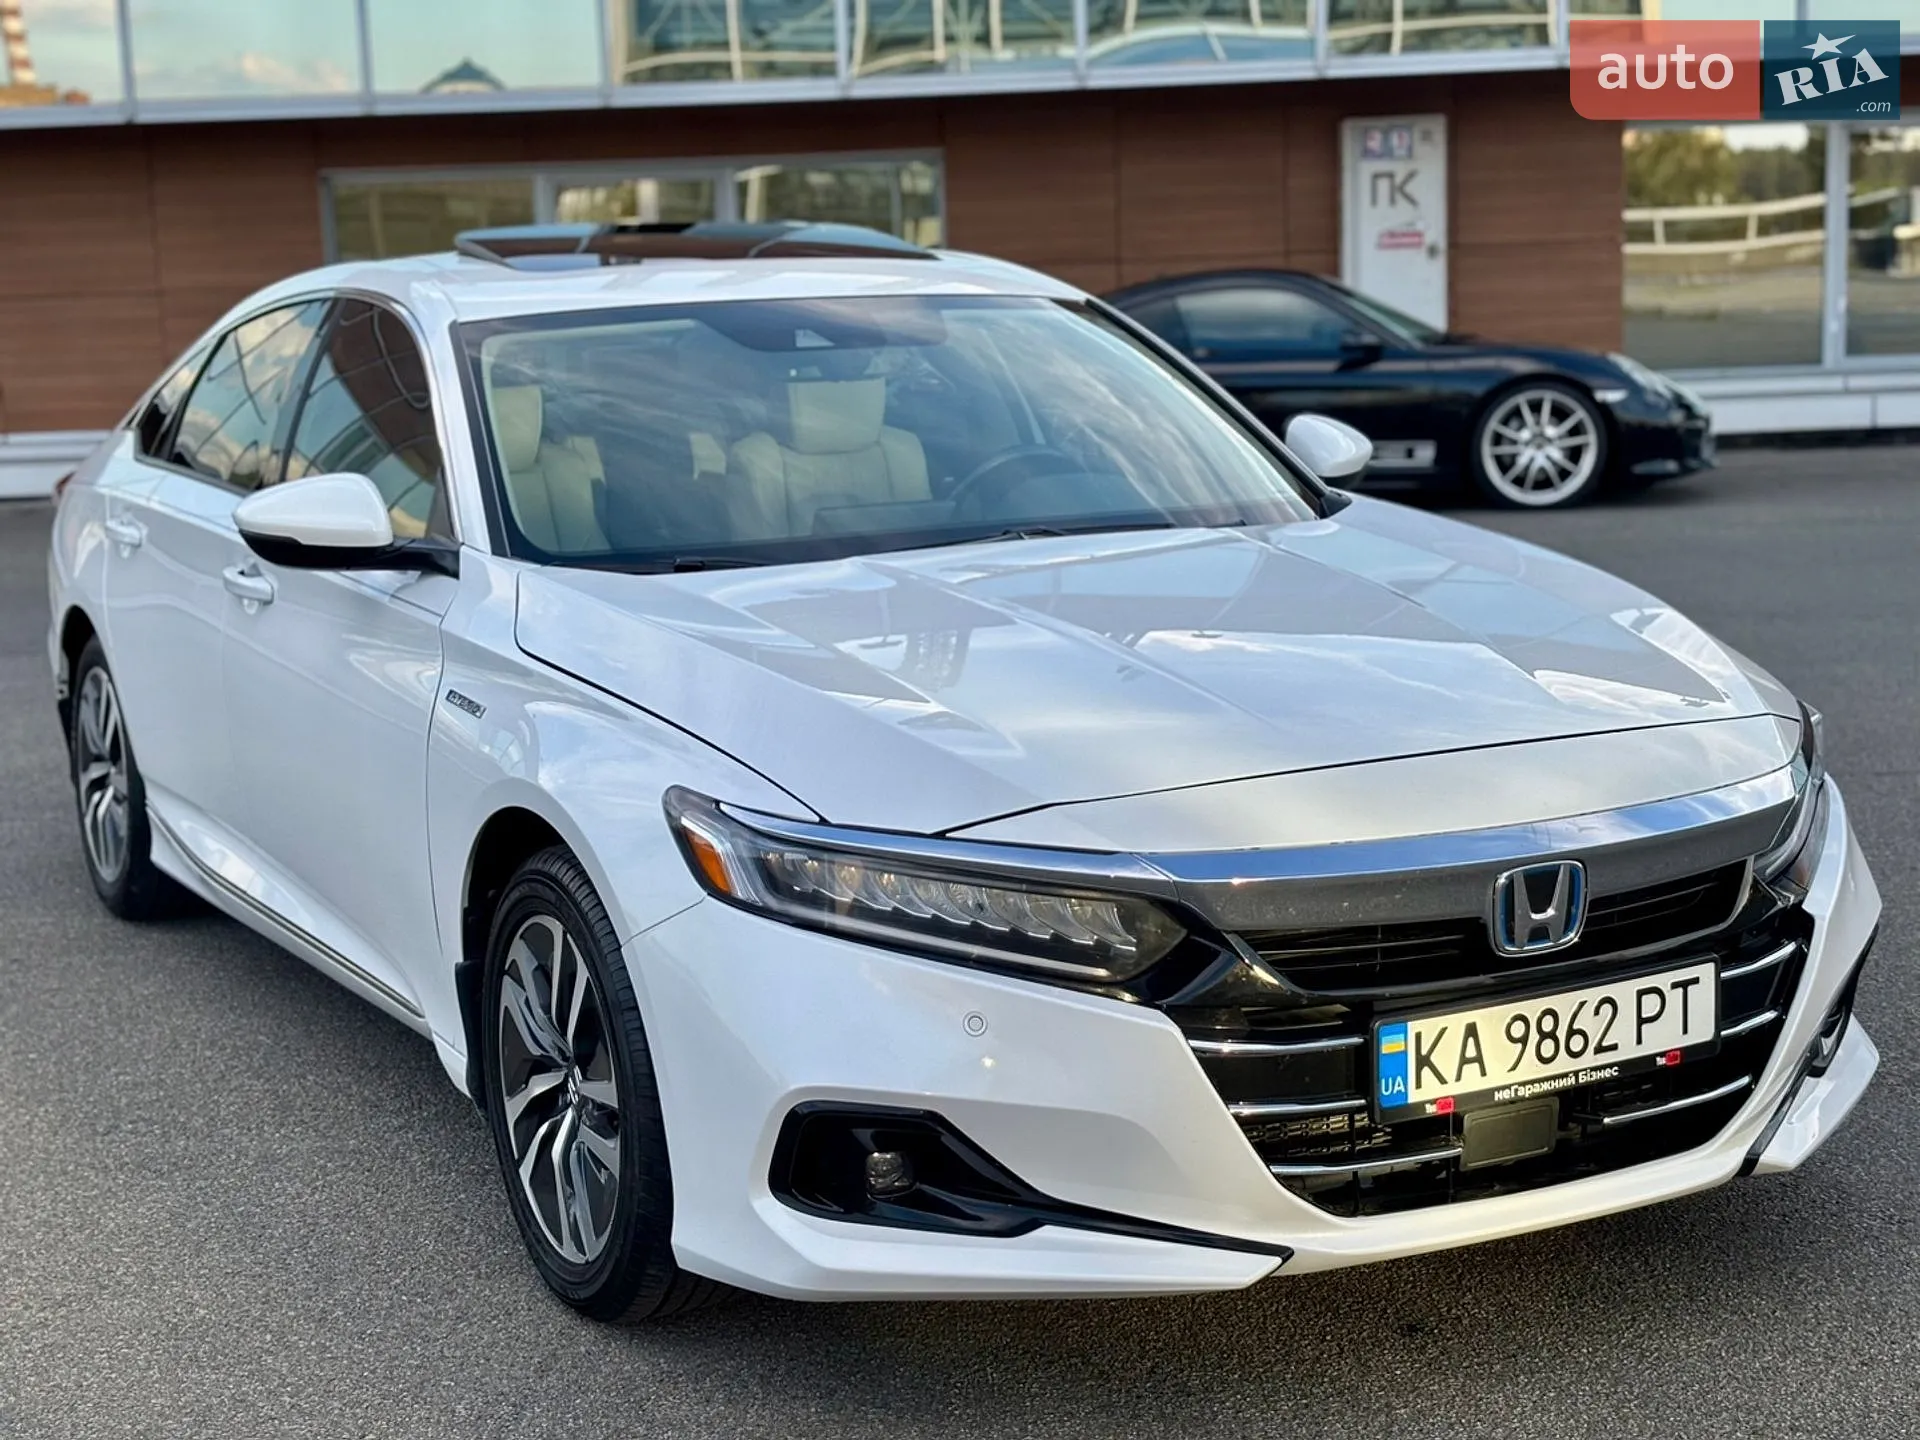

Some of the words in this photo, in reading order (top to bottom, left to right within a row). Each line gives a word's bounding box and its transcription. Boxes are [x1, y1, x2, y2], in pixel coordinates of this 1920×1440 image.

[1371, 169, 1418, 208] ПК
[1414, 1021, 1488, 1090] KA
[1504, 995, 1619, 1073] 9862
[1635, 976, 1700, 1046] PT
[1381, 1075, 1406, 1097] UA
[1494, 1073, 1576, 1101] неГаражний
[1578, 1066, 1620, 1084] Бізнес
